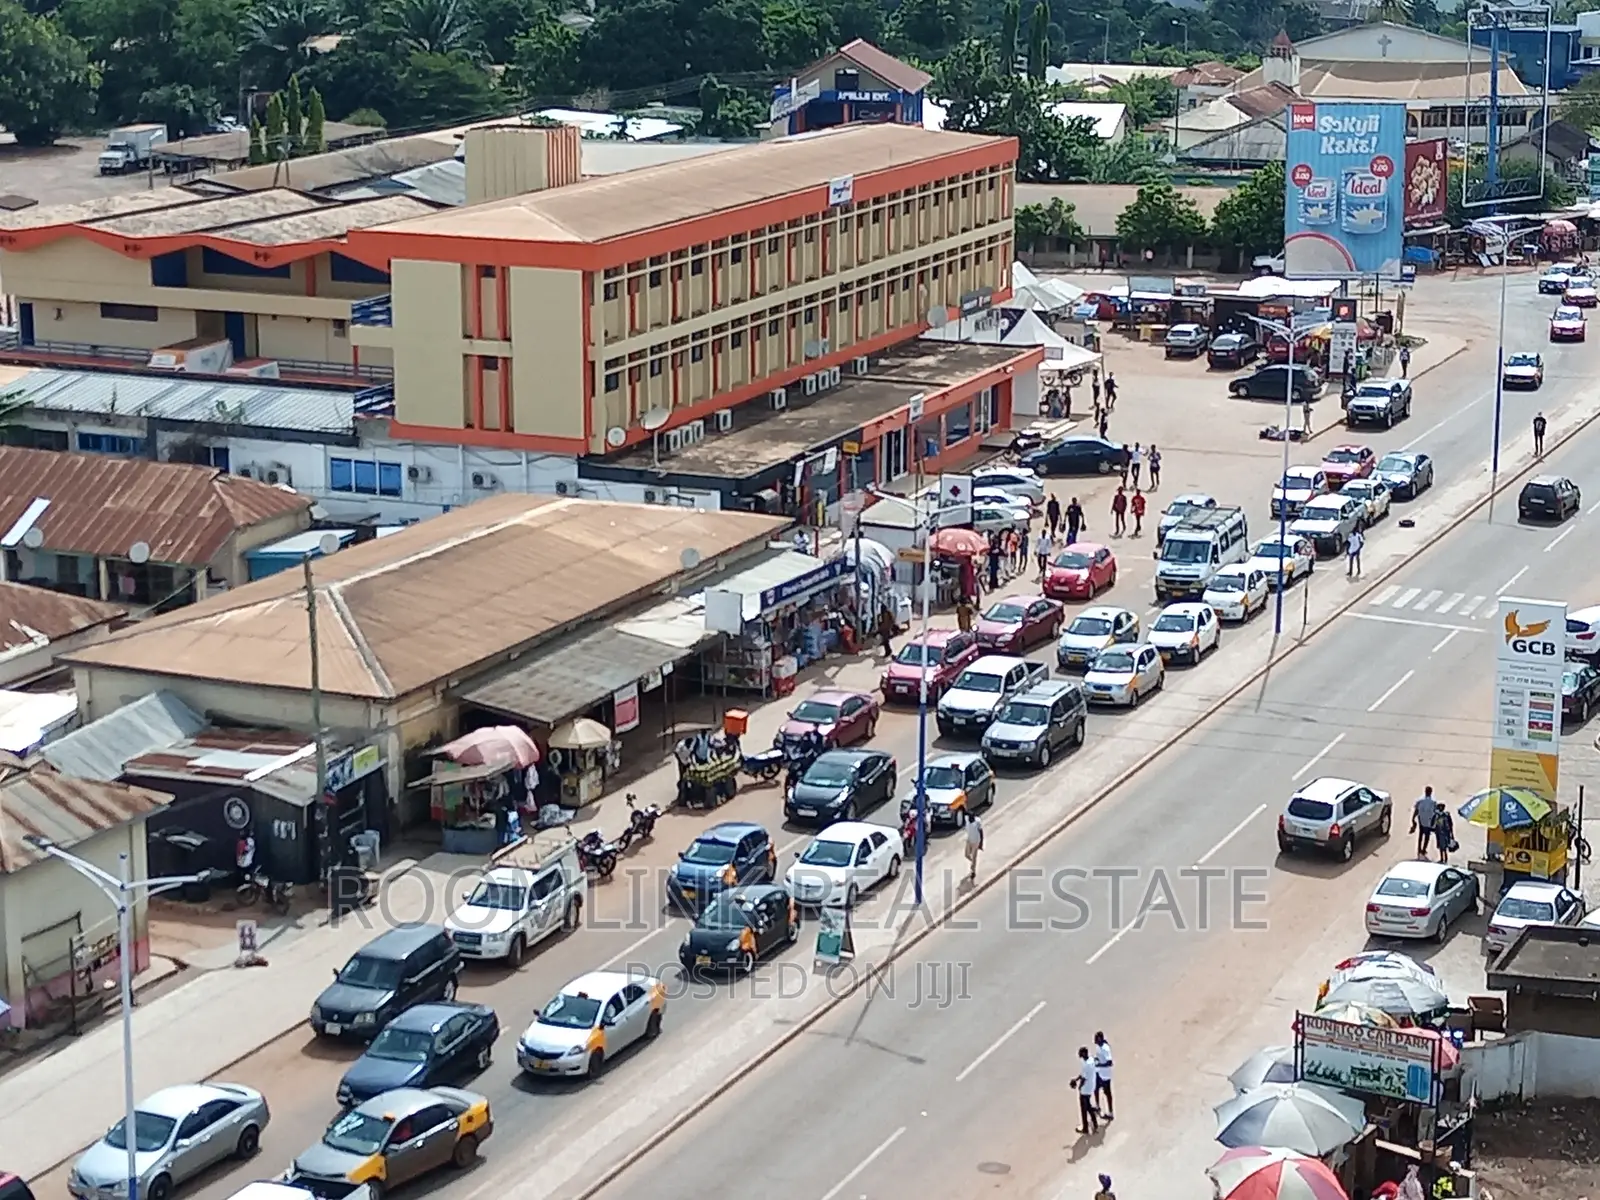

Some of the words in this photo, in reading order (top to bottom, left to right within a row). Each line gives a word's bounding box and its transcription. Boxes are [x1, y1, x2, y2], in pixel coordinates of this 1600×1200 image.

[1307, 187, 1327, 198] Ideal
[1351, 178, 1382, 195] Ideal
[1512, 639, 1556, 656] GCB
